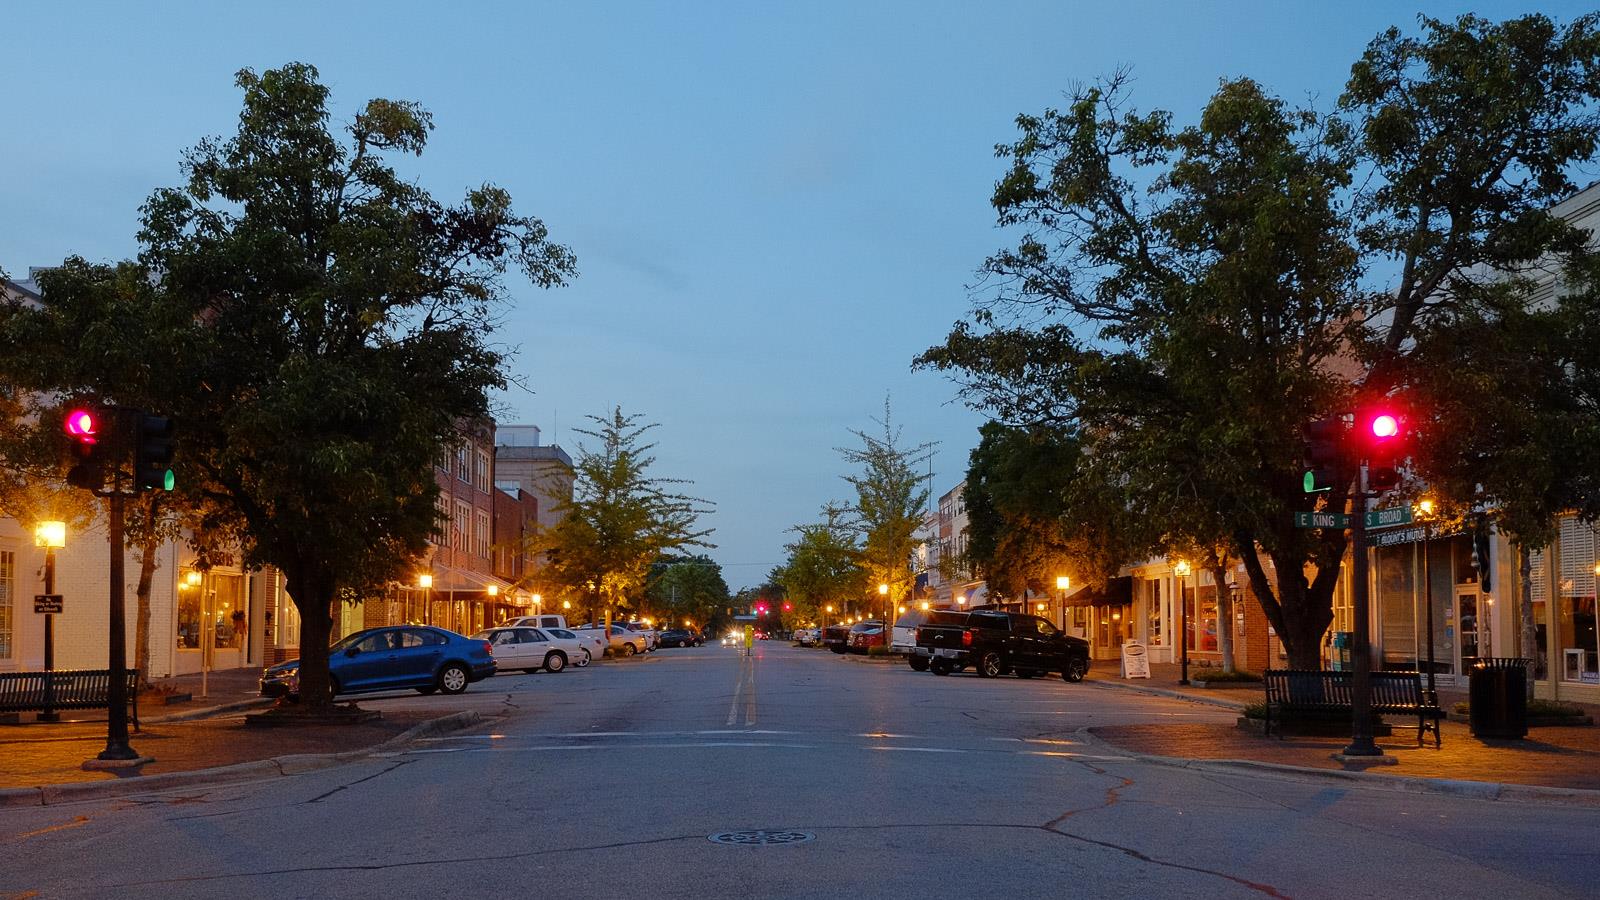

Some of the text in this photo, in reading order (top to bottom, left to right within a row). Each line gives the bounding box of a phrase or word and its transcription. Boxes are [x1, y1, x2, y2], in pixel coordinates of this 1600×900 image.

[1301, 514, 1308, 526] E
[1313, 514, 1335, 527] KING
[1366, 513, 1372, 526] S
[1379, 509, 1402, 524] BROAD
